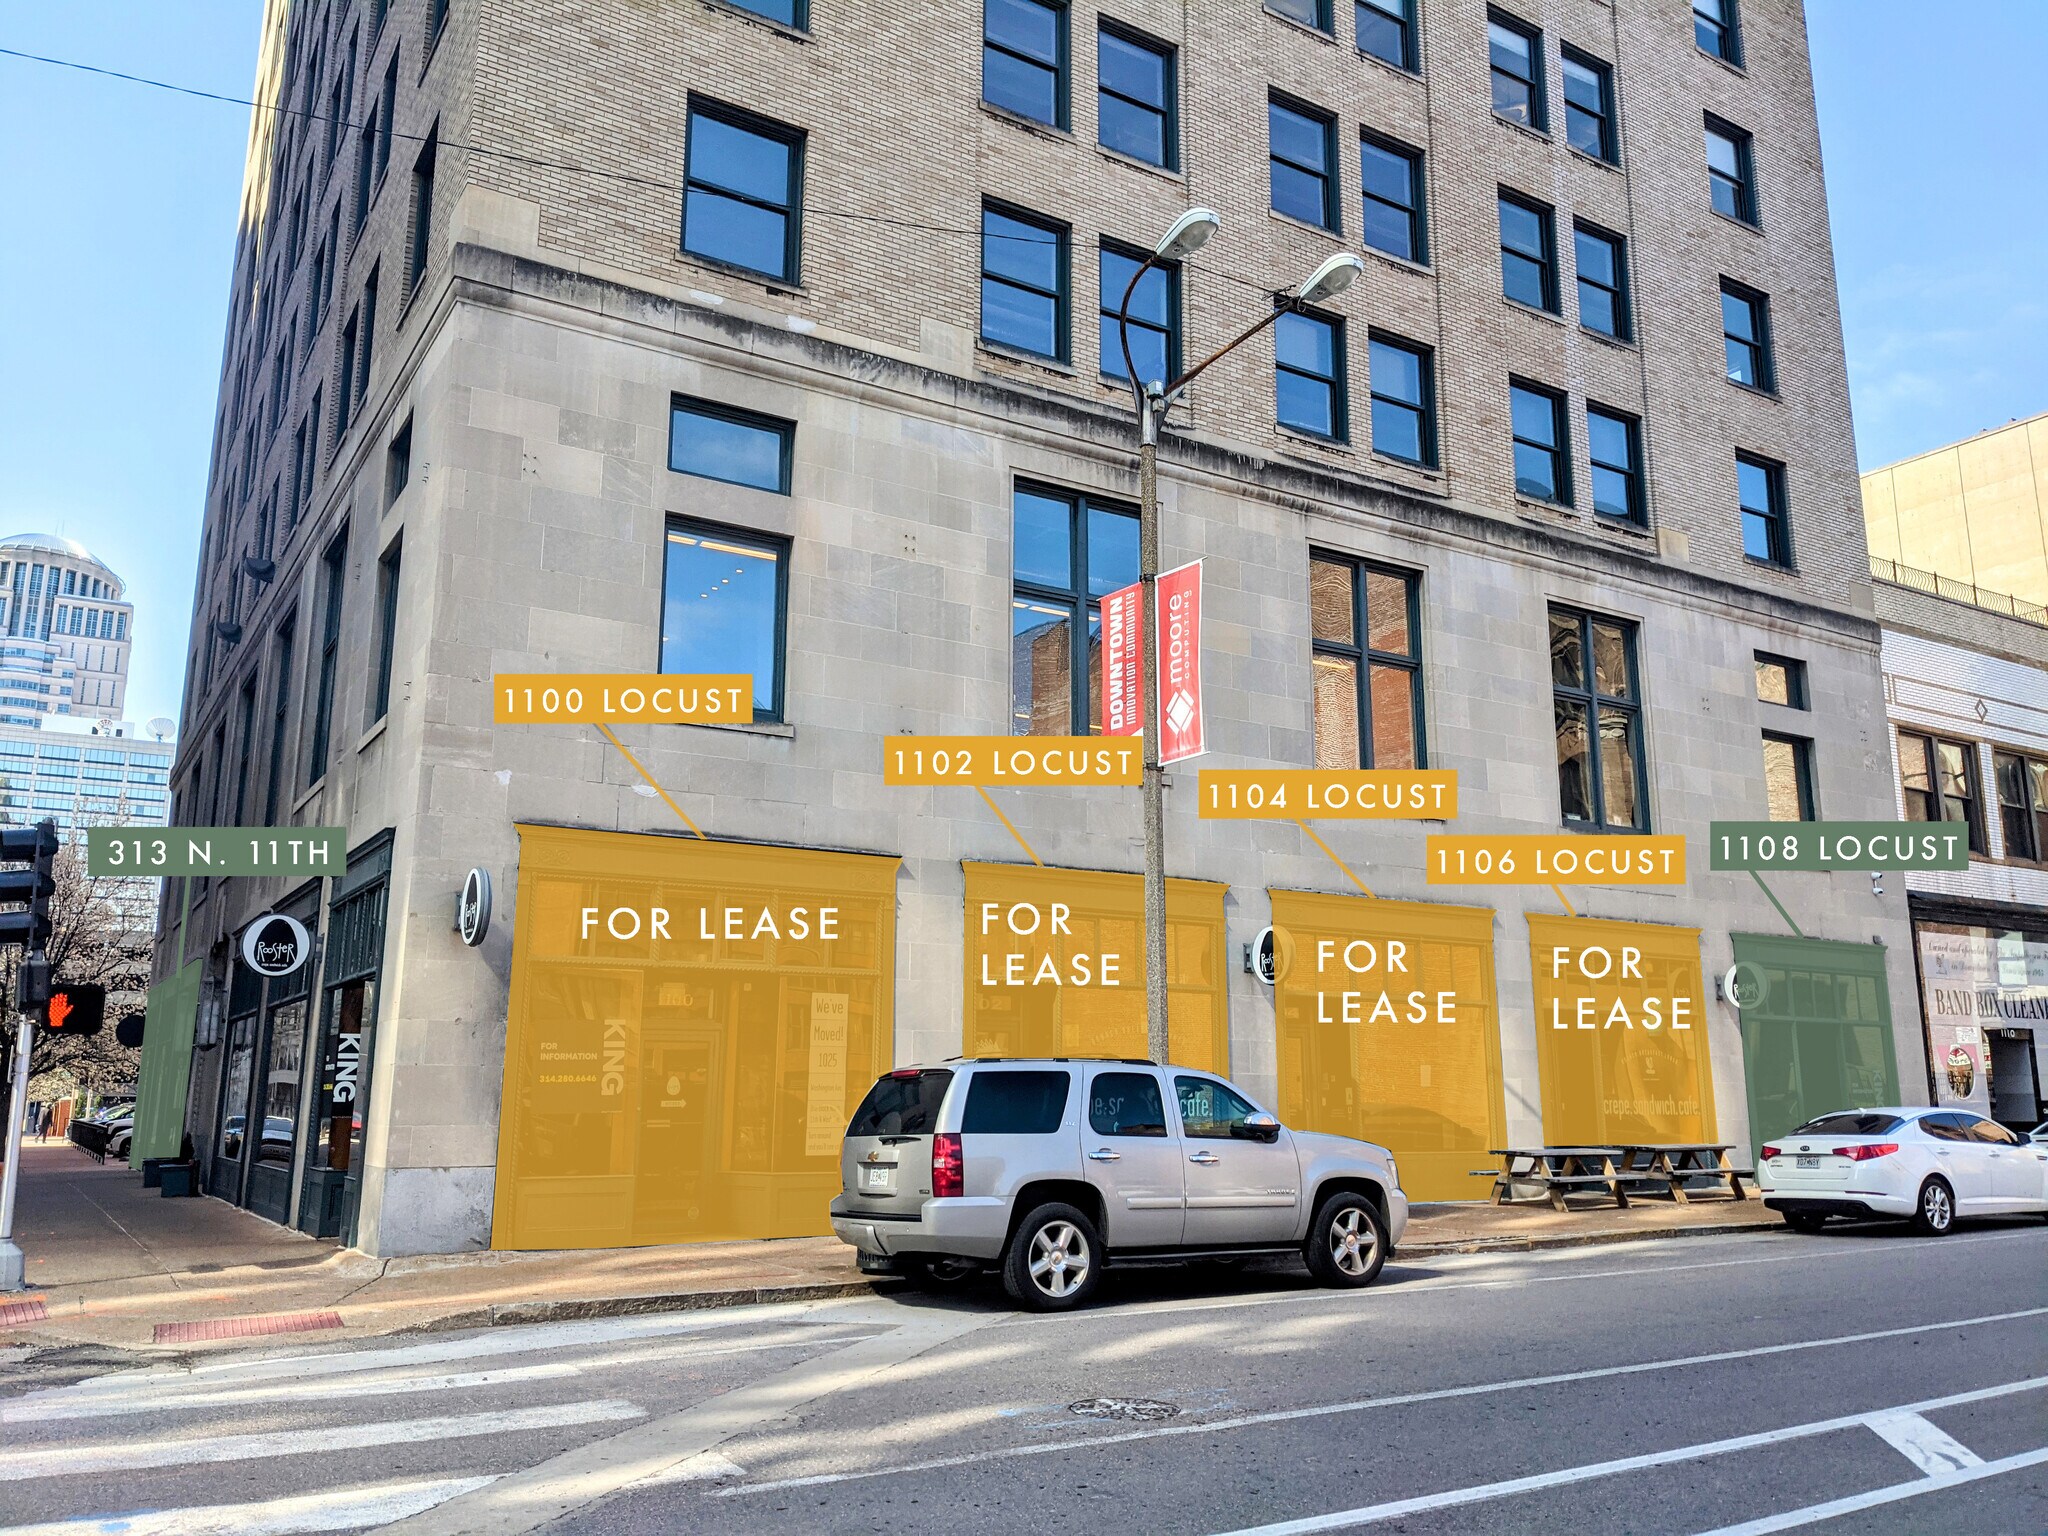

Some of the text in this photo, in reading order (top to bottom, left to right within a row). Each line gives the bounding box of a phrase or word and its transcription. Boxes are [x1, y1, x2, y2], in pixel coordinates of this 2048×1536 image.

[1126, 591, 1136, 660] COMMUNITY
[1169, 593, 1182, 684] moore
[1110, 596, 1123, 730] DOWNTOWN
[816, 998, 843, 1014] We've
[1935, 988, 1972, 1016] BAND
[1975, 991, 2002, 1018] BOX
[540, 1053, 598, 1061] INFORMATION
[601, 1019, 626, 1096] KING
[814, 1025, 843, 1041] Moved!
[333, 1033, 361, 1103] KING
[818, 1052, 837, 1068] 1025
